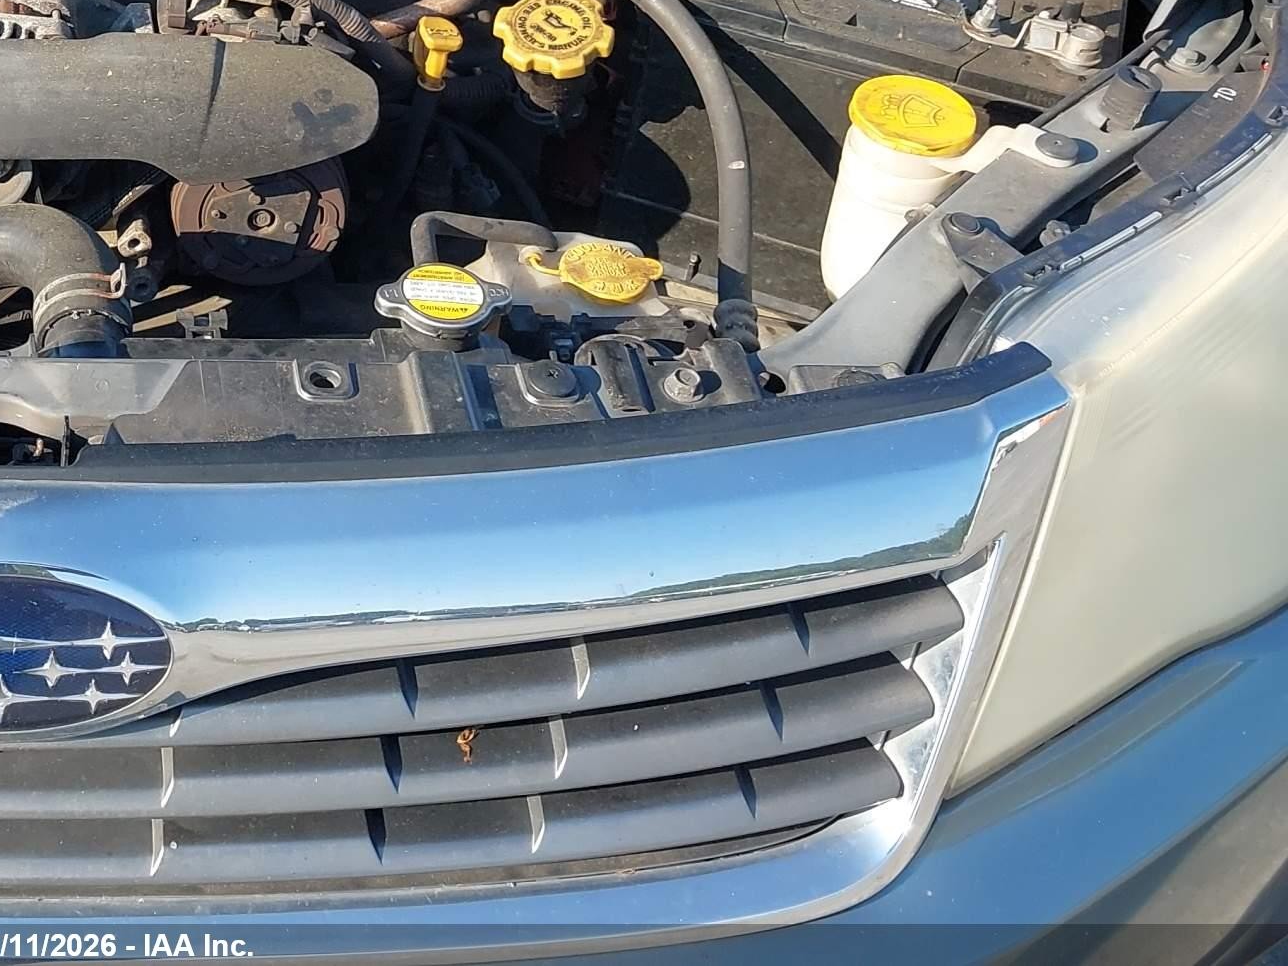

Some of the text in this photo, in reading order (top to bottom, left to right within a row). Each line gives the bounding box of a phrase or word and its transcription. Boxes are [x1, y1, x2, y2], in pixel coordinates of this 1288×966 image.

[582, 16, 593, 30] OIL
[548, 35, 589, 51] MANUAL
[419, 303, 461, 314] WARNING
